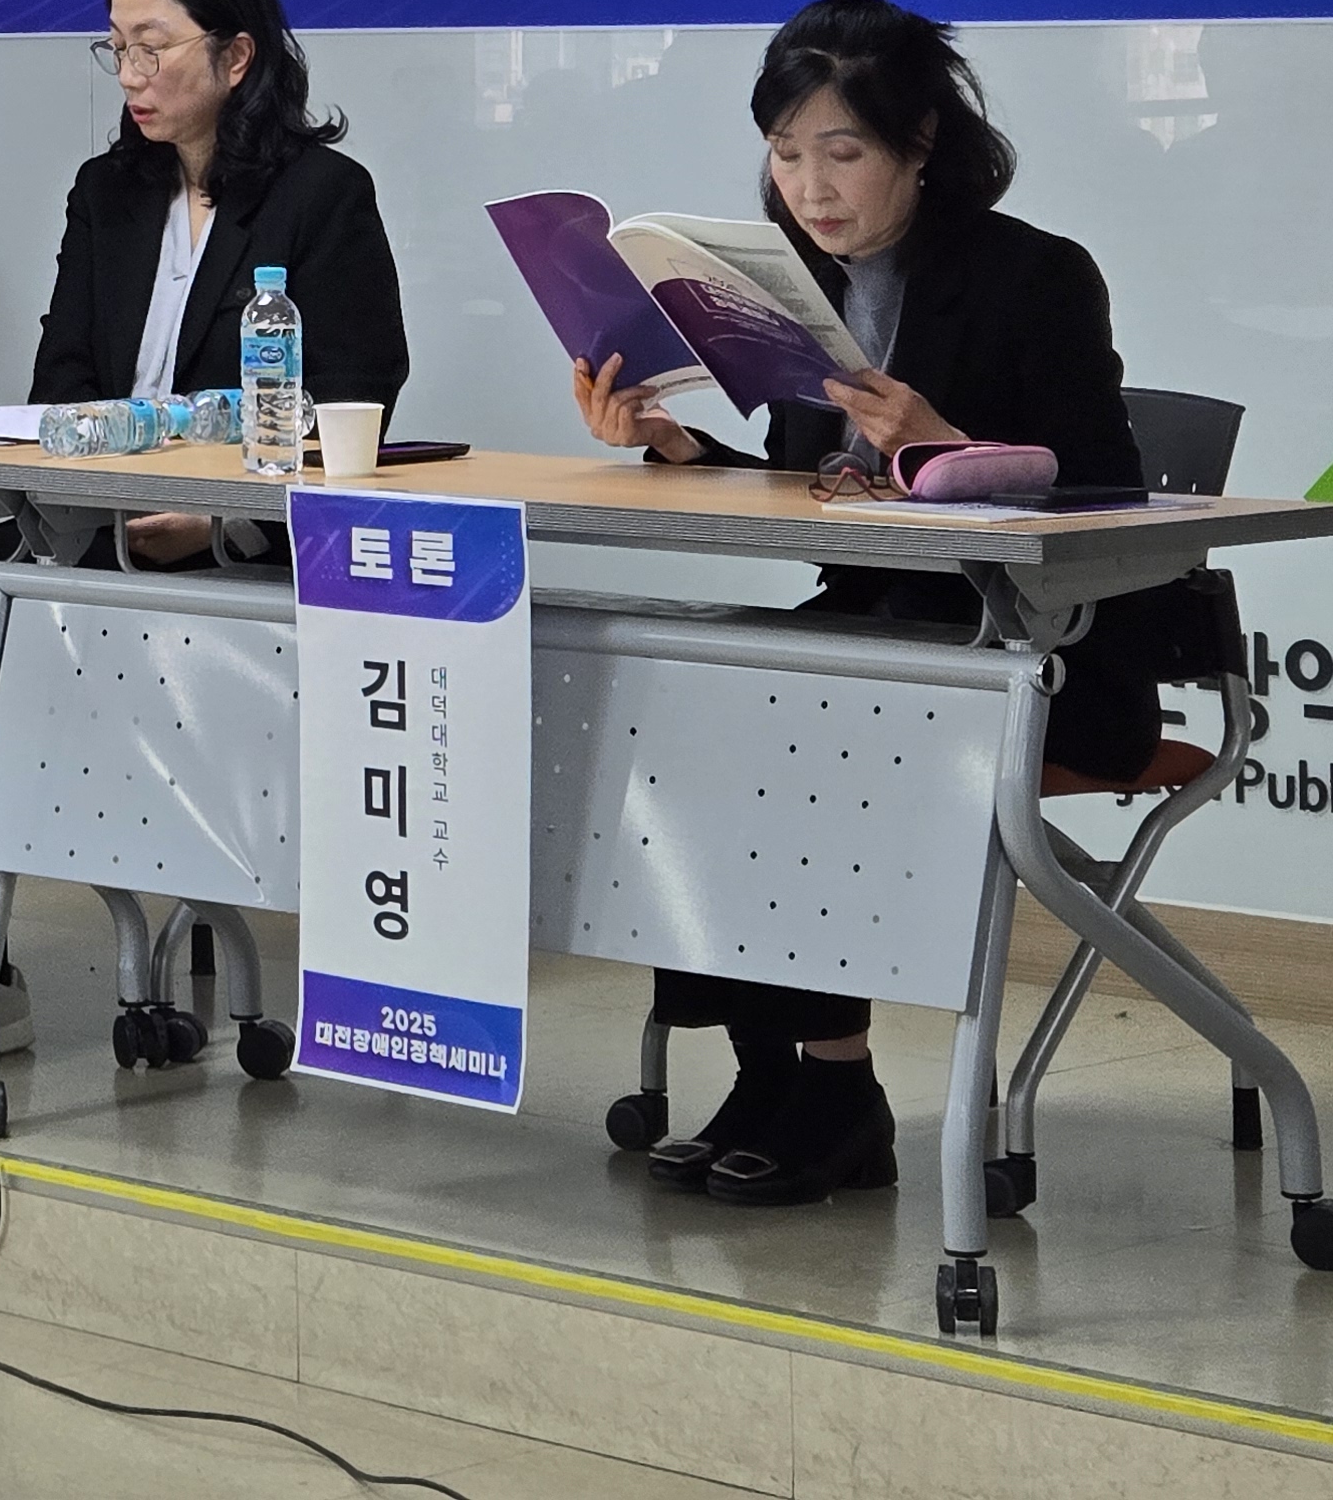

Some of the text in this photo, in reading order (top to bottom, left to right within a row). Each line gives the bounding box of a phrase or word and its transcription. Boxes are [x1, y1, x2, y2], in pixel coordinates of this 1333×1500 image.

[349, 526, 456, 587] 토론
[431, 666, 449, 871] 대덕대학교 교수
[1235, 757, 1333, 813] Pub
[361, 659, 409, 941] 김미영
[314, 1020, 508, 1080] 대전장애인정책세미나
[381, 1006, 438, 1037] 2025
